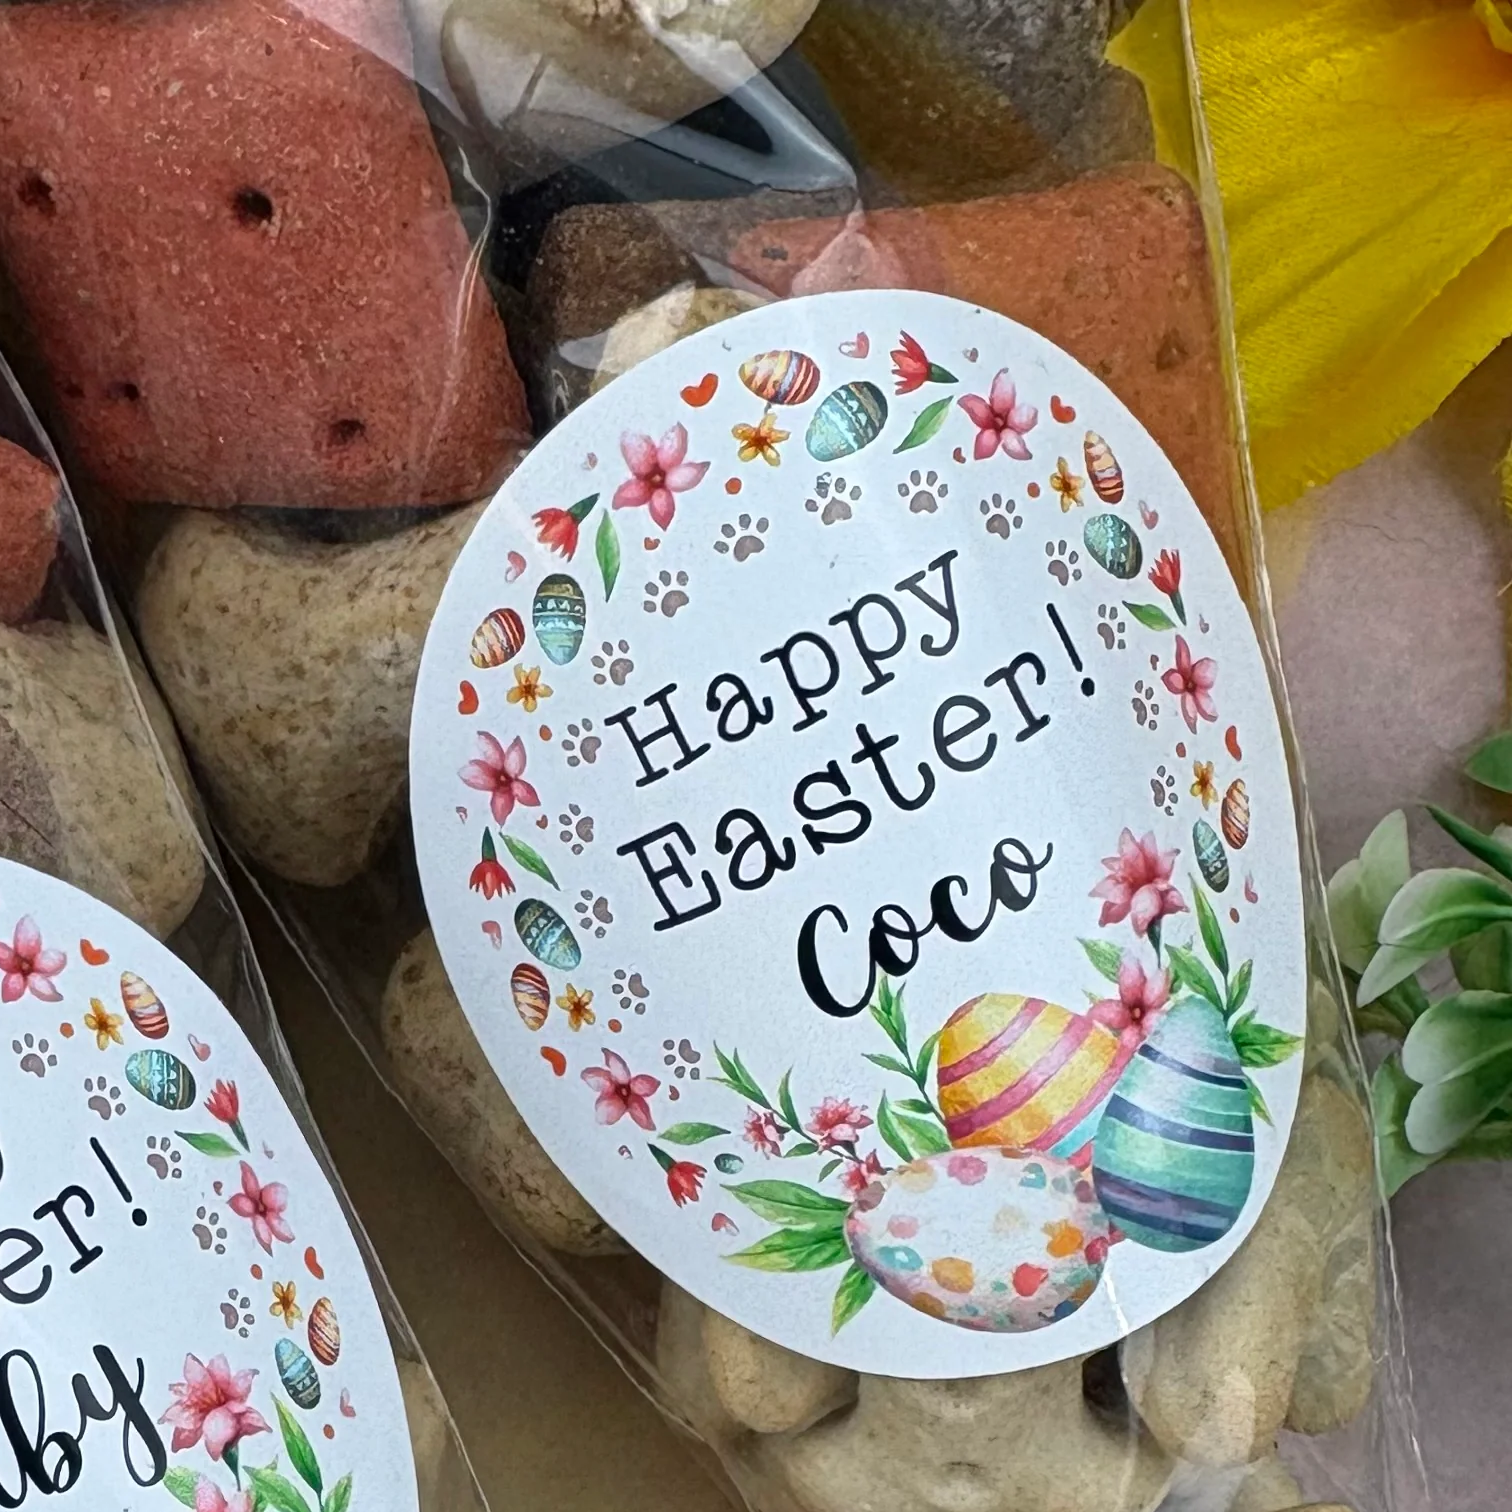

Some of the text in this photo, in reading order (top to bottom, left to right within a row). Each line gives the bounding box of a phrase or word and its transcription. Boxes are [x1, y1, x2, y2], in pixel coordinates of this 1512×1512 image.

[603, 548, 960, 789] Happy
[616, 602, 1097, 933] Easter!
[796, 837, 1055, 1019] Coco
